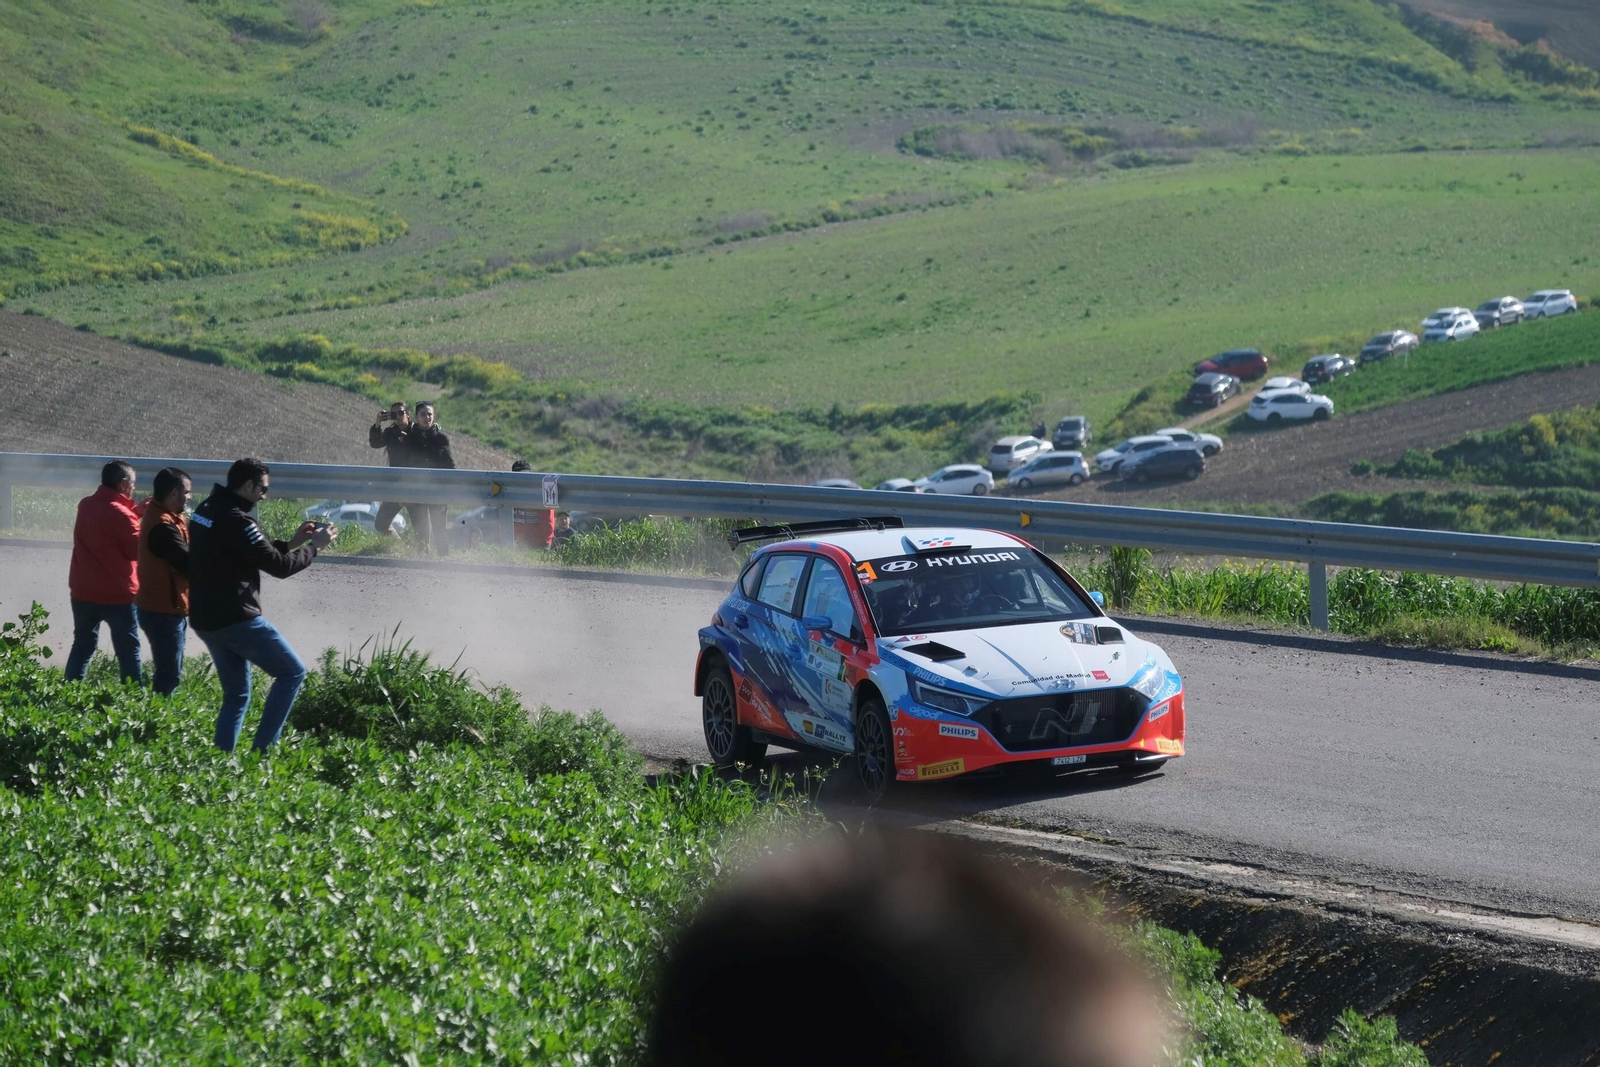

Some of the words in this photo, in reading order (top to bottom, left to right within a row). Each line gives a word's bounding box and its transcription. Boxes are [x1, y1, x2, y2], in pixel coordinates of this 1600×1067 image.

[926, 551, 1021, 568] HYUNDAI
[856, 561, 878, 580] 1
[912, 666, 947, 687] PHILIPS
[1011, 675, 1054, 686] Comunidad
[1150, 704, 1169, 719] PHILIPS
[824, 729, 847, 743] RALLYE
[940, 726, 976, 737] PHILIPS
[1056, 756, 1070, 764] 7412
[922, 761, 960, 776] PIRELLI
